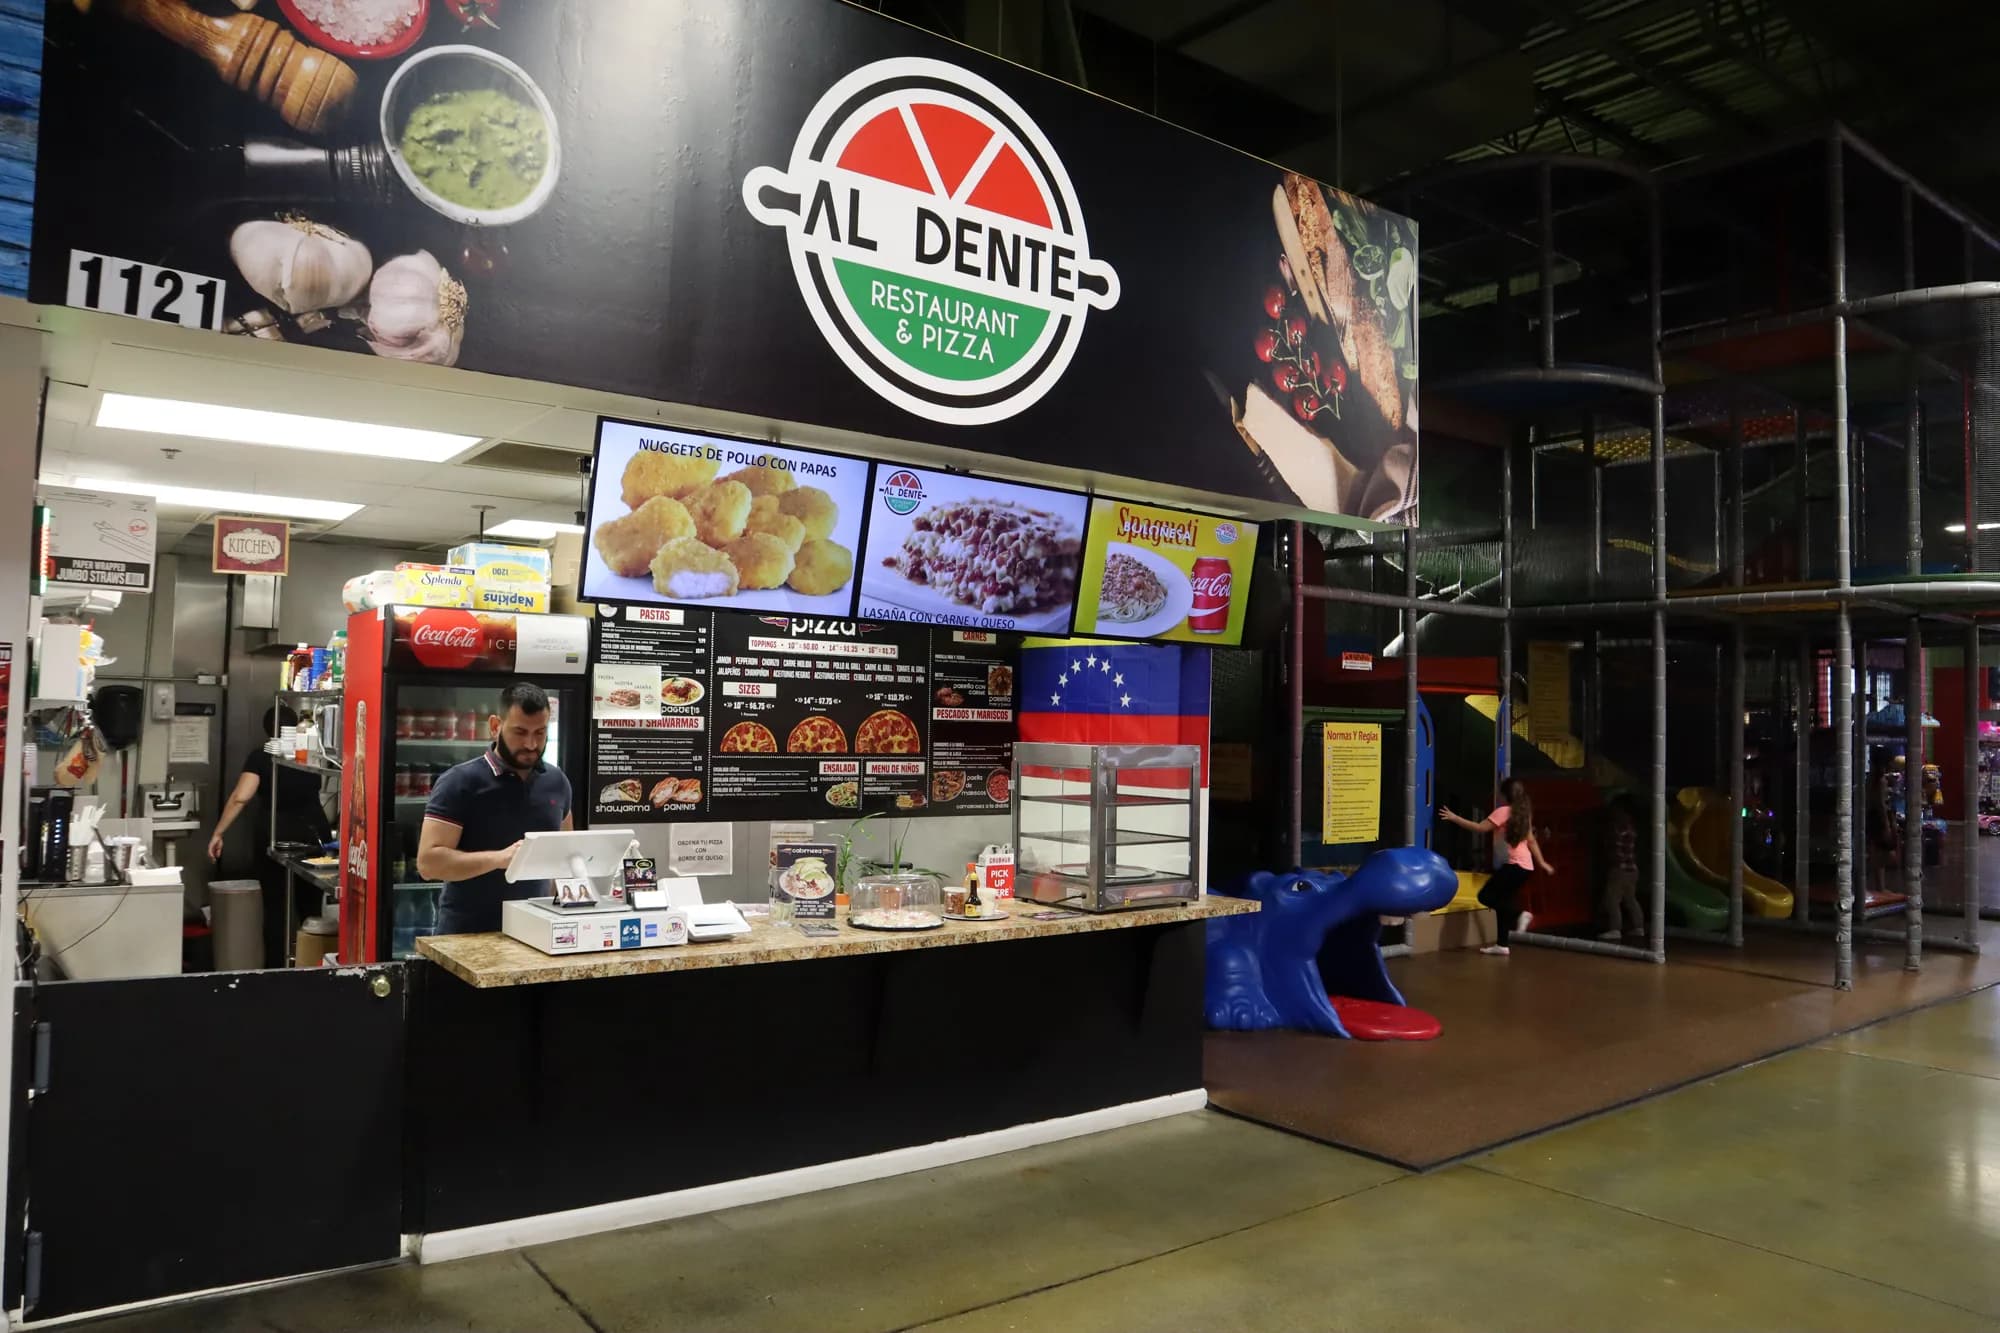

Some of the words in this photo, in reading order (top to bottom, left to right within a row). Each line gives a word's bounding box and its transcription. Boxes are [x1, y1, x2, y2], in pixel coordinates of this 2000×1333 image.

[803, 179, 878, 252] AL
[915, 206, 1075, 302] DENTE
[80, 256, 217, 330] 1121
[871, 280, 1019, 339] RESTAURANT
[896, 319, 912, 344] &
[923, 324, 994, 363] PIZZA
[639, 438, 703, 458] NUGGETS
[706, 449, 723, 461] DE
[727, 452, 767, 467] POLLO
[770, 457, 797, 472] CON
[800, 462, 837, 478] PAPAS
[884, 486, 894, 495] AL
[898, 488, 922, 500] DENTE
[1117, 506, 1199, 547] Spagueti
[228, 538, 275, 554] KITCHEN
[72, 560, 94, 569] PAPER
[94, 561, 126, 572] WRAPPED
[57, 568, 88, 580] JUMBO
[89, 570, 125, 584] STRAWS
[421, 572, 462, 587] Splenda
[484, 592, 534, 607] Napkins
[640, 609, 670, 620] PASTAS
[864, 607, 906, 622] LASAÑA
[909, 611, 933, 624] CON
[935, 613, 969, 626] CARNE
[972, 617, 979, 627] Y
[982, 617, 1015, 629] QUESO
[413, 624, 479, 648] Coca-Cola
[489, 639, 516, 650] ICE
[751, 640, 776, 648] TOPPINGS
[738, 684, 760, 694] SIZES
[937, 709, 969, 719] PESCADOS
[971, 710, 975, 719] Y
[977, 710, 1008, 720] MARISCOS
[602, 719, 636, 728] PANINIS
[646, 718, 699, 728] SHAWARMAS
[1327, 730, 1351, 741] Normas
[1353, 731, 1358, 740] Y
[1359, 731, 1378, 744] Reglas
[823, 764, 856, 773] ENSALADA
[872, 764, 890, 773] MENU
[891, 764, 899, 773] DE
[901, 763, 919, 773] NIÑOS
[595, 803, 650, 813] shawarma
[991, 869, 1009, 878] PICK
